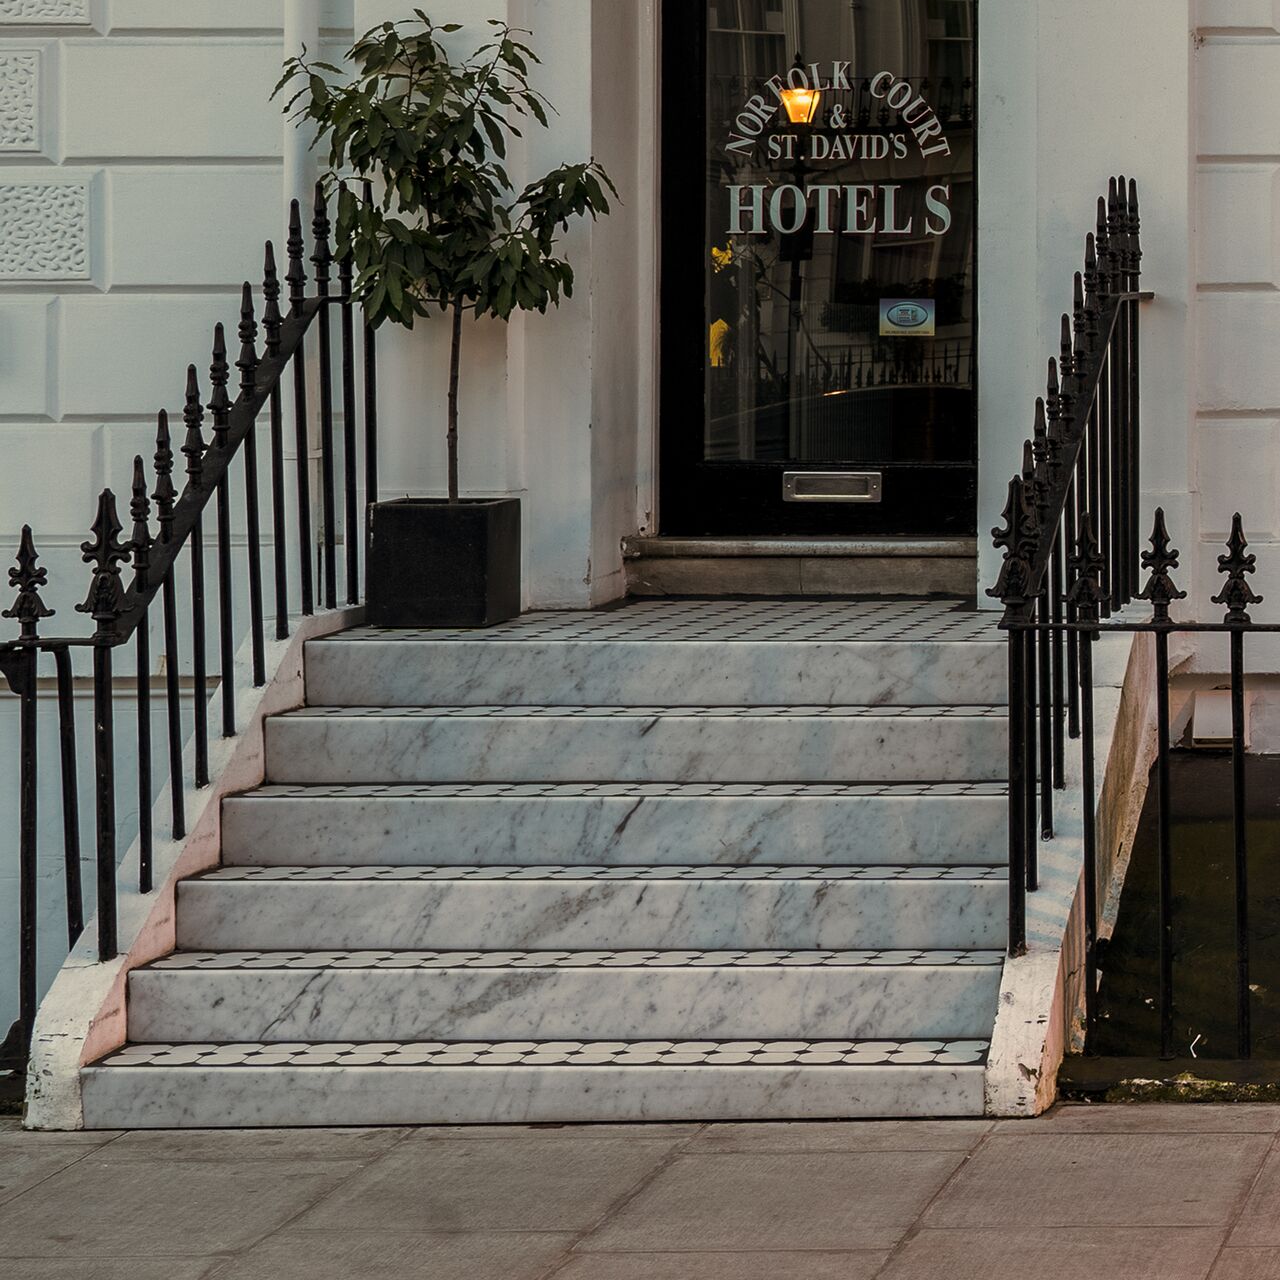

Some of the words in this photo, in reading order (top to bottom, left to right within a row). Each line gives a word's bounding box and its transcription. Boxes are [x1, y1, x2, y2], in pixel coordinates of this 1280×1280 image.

[725, 60, 851, 156] NORFOLK
[869, 71, 951, 159] COURT
[829, 103, 847, 129] &
[767, 134, 805, 160] ST.
[810, 133, 908, 160] DAVID'S
